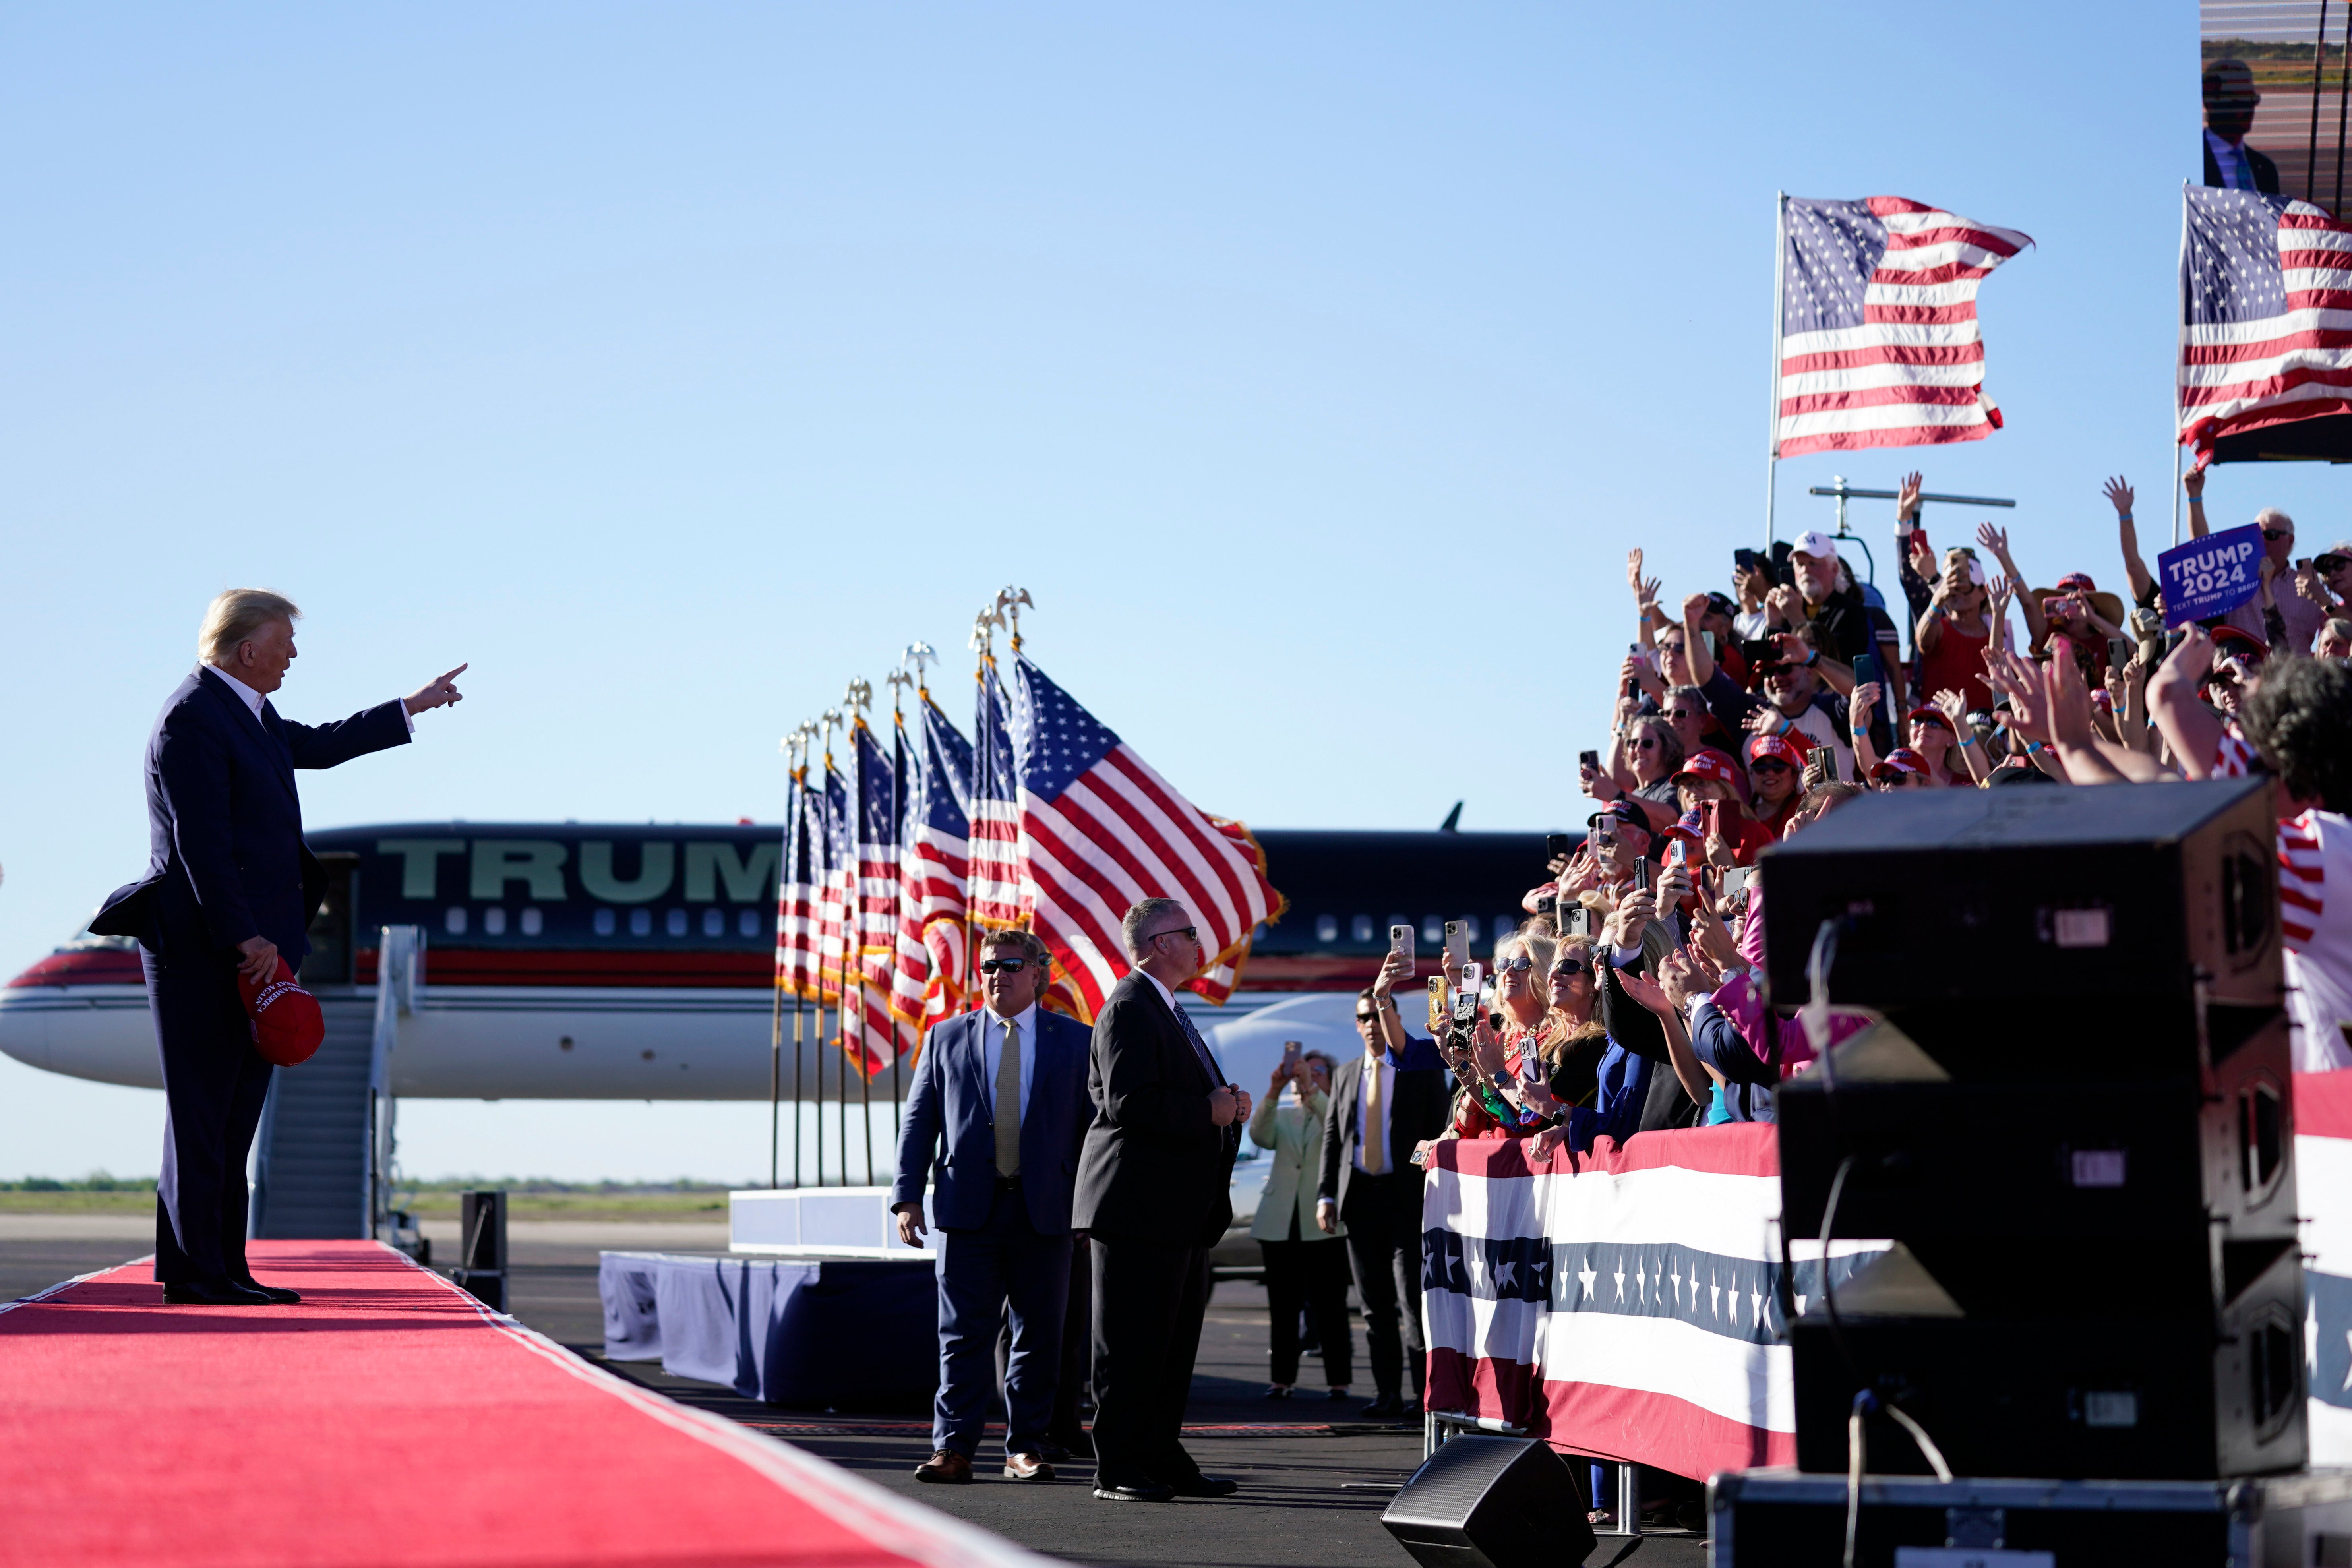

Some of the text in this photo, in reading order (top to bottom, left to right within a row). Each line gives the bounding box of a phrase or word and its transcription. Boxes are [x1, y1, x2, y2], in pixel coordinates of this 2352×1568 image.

[2168, 542, 2253, 582] TRUMP
[2182, 564, 2246, 598] 2024
[2172, 600, 2191, 612] TEXT
[2193, 592, 2222, 605] TRUMP
[2225, 588, 2236, 596] TO
[1756, 741, 1786, 751] AMERICA
[1692, 754, 1716, 763] ERICA
[1694, 761, 1712, 770] AGAIN
[256, 984, 275, 1005] AGAIN
[257, 987, 288, 1012] AMERICA
